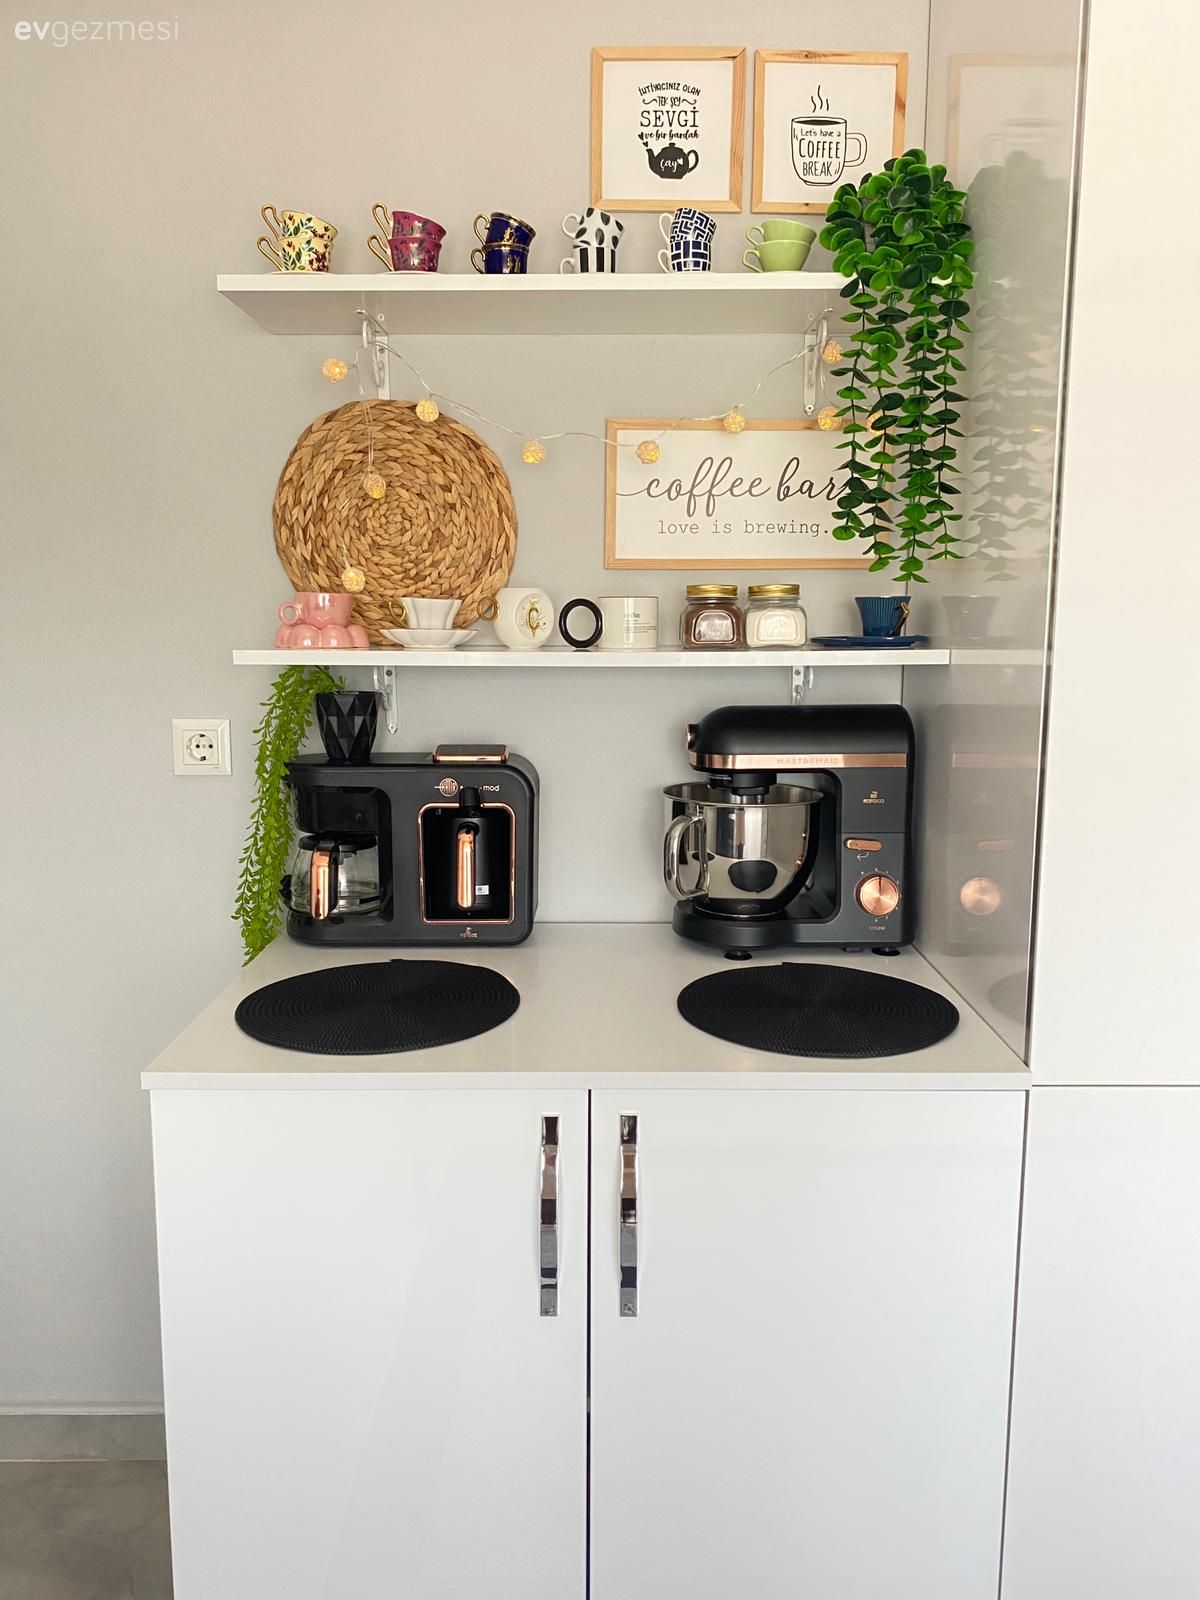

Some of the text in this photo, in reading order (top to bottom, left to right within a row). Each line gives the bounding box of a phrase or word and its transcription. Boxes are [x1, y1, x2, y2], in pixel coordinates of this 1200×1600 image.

[682, 84, 701, 97] OLAN
[657, 95, 669, 107] TEK
[640, 106, 700, 128] SEVGİ
[655, 129, 668, 141] bir
[668, 129, 700, 141] bardak
[800, 128, 818, 137] Let's
[819, 128, 835, 137] have
[799, 138, 841, 159] COFFEE
[660, 158, 678, 173] çay
[802, 160, 833, 177] BREAK
[616, 456, 848, 518] coffee bar
[657, 519, 829, 538] love is brewing.
